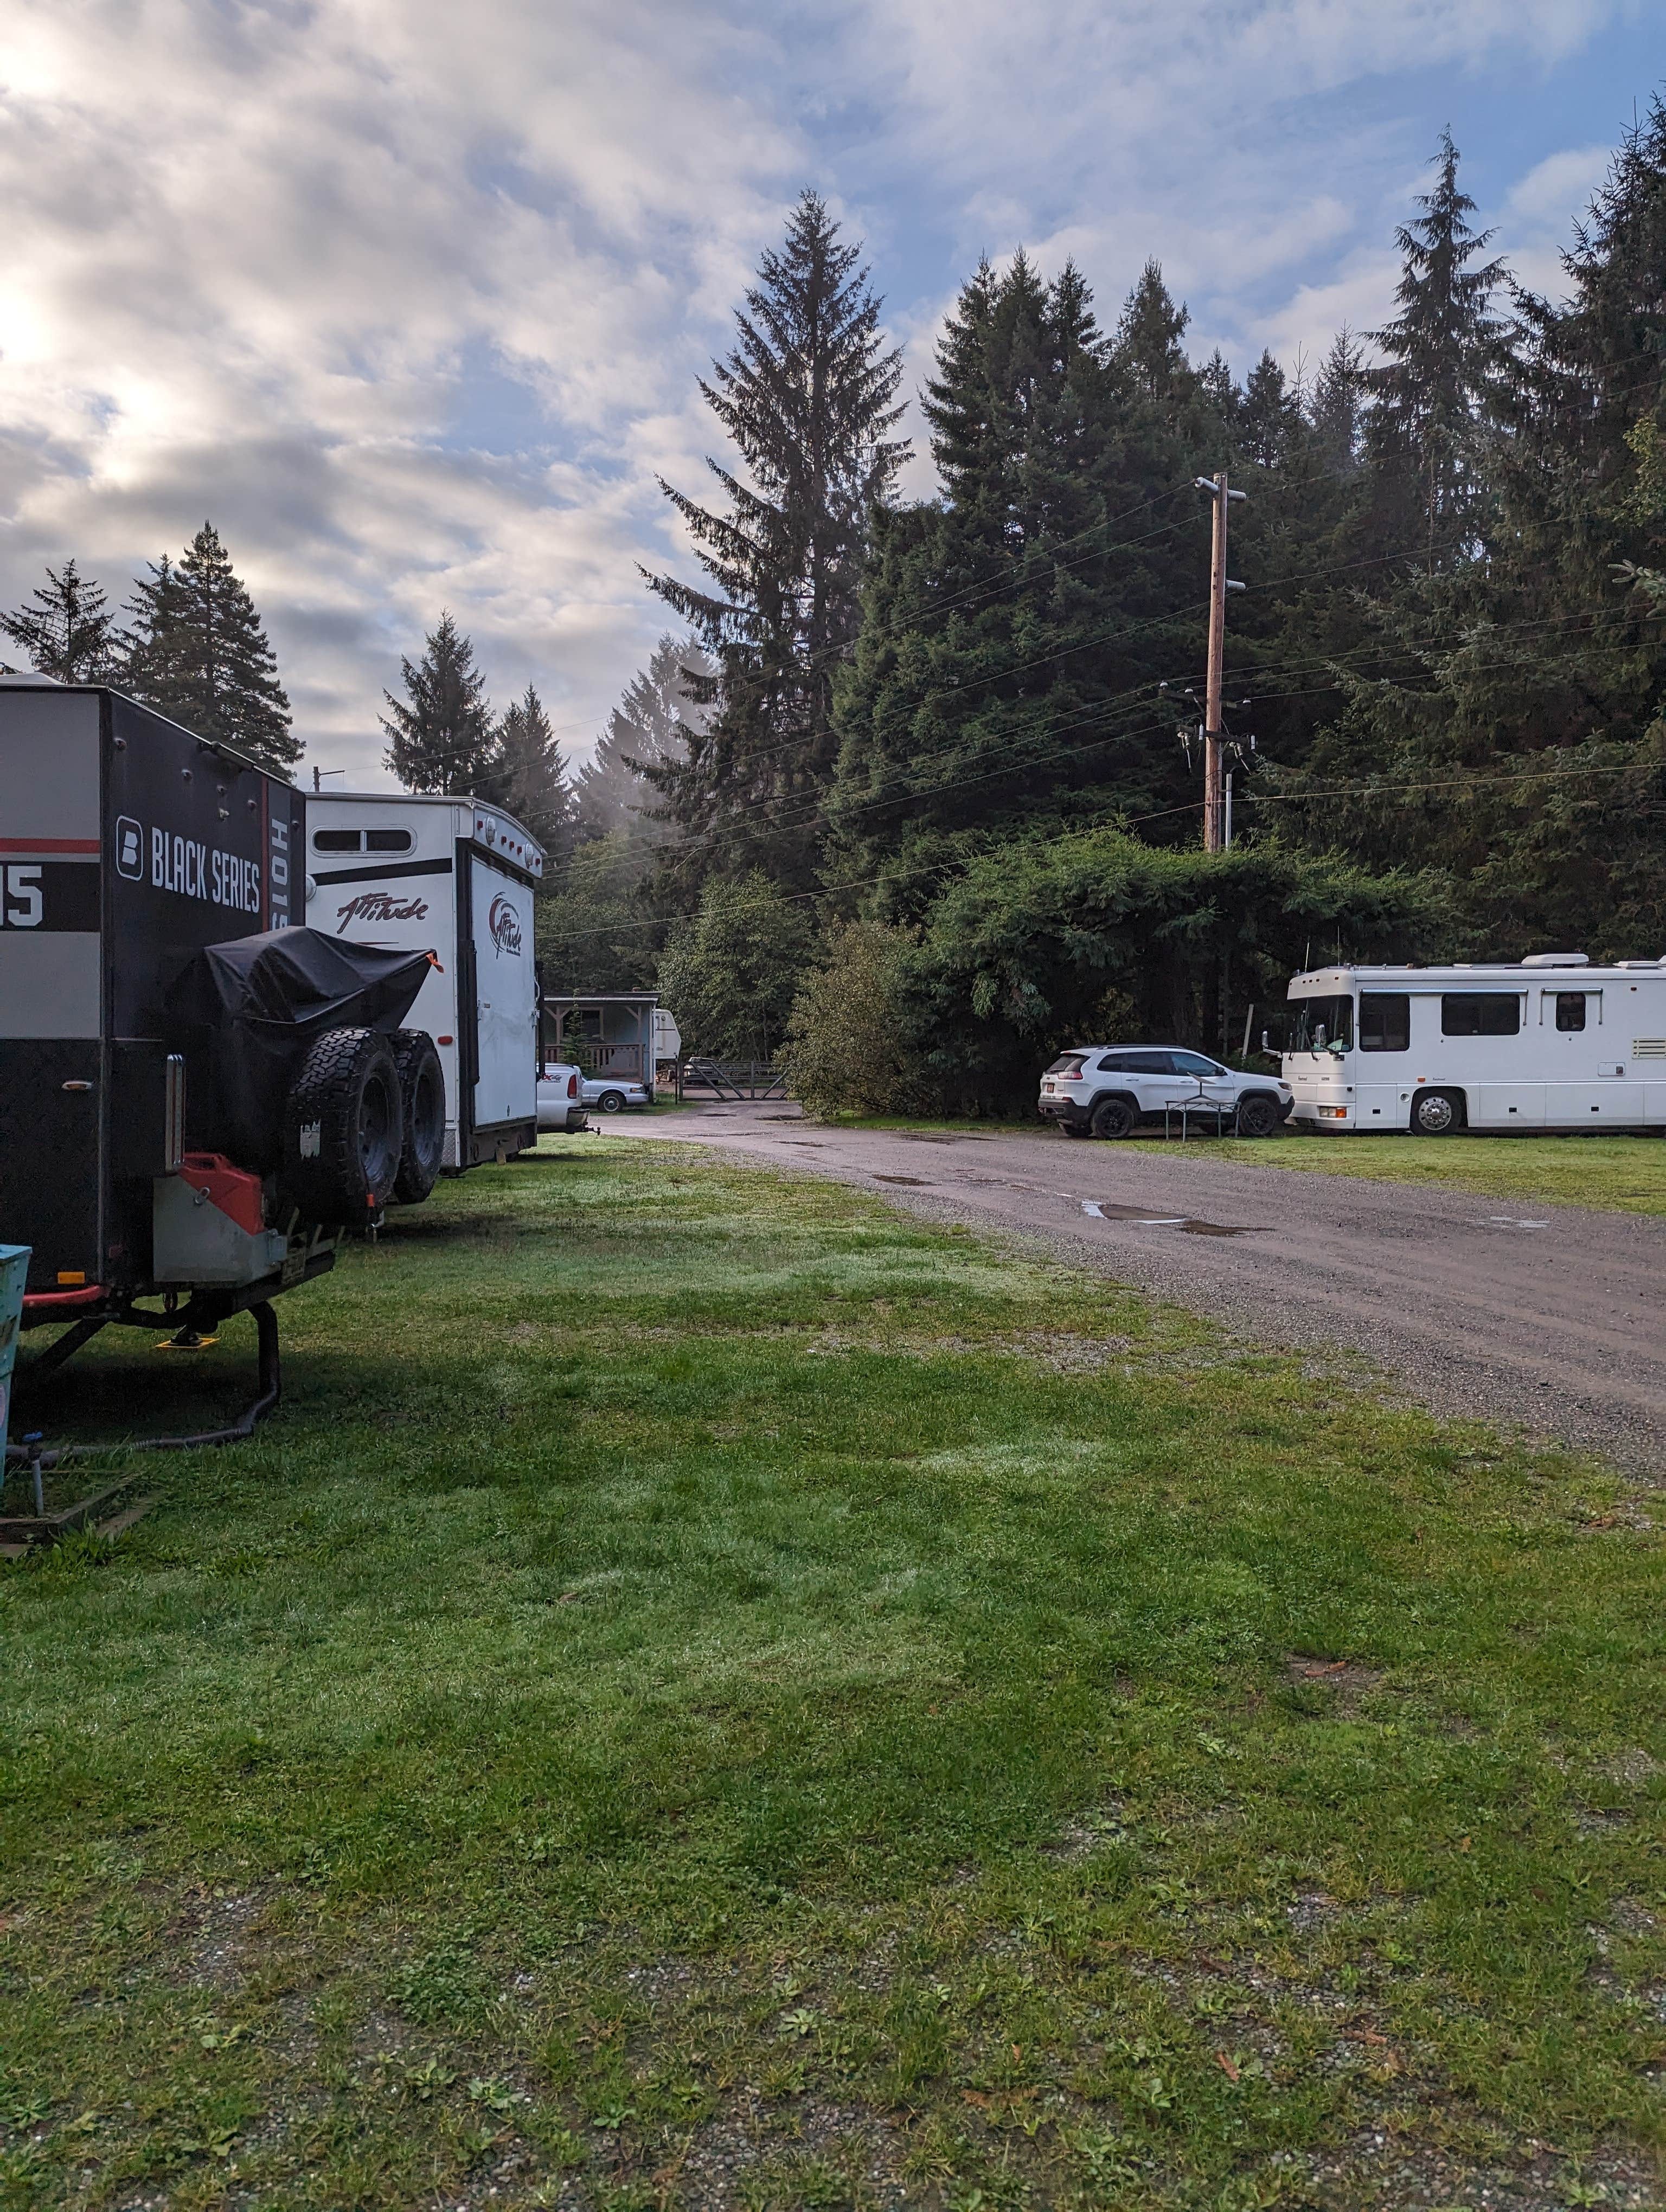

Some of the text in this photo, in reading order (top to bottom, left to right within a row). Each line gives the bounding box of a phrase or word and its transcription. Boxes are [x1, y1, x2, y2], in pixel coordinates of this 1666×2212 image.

[0, 865, 42, 926] 5
[152, 826, 259, 913] BLACK SERIES
[336, 892, 428, 934] Attitude
